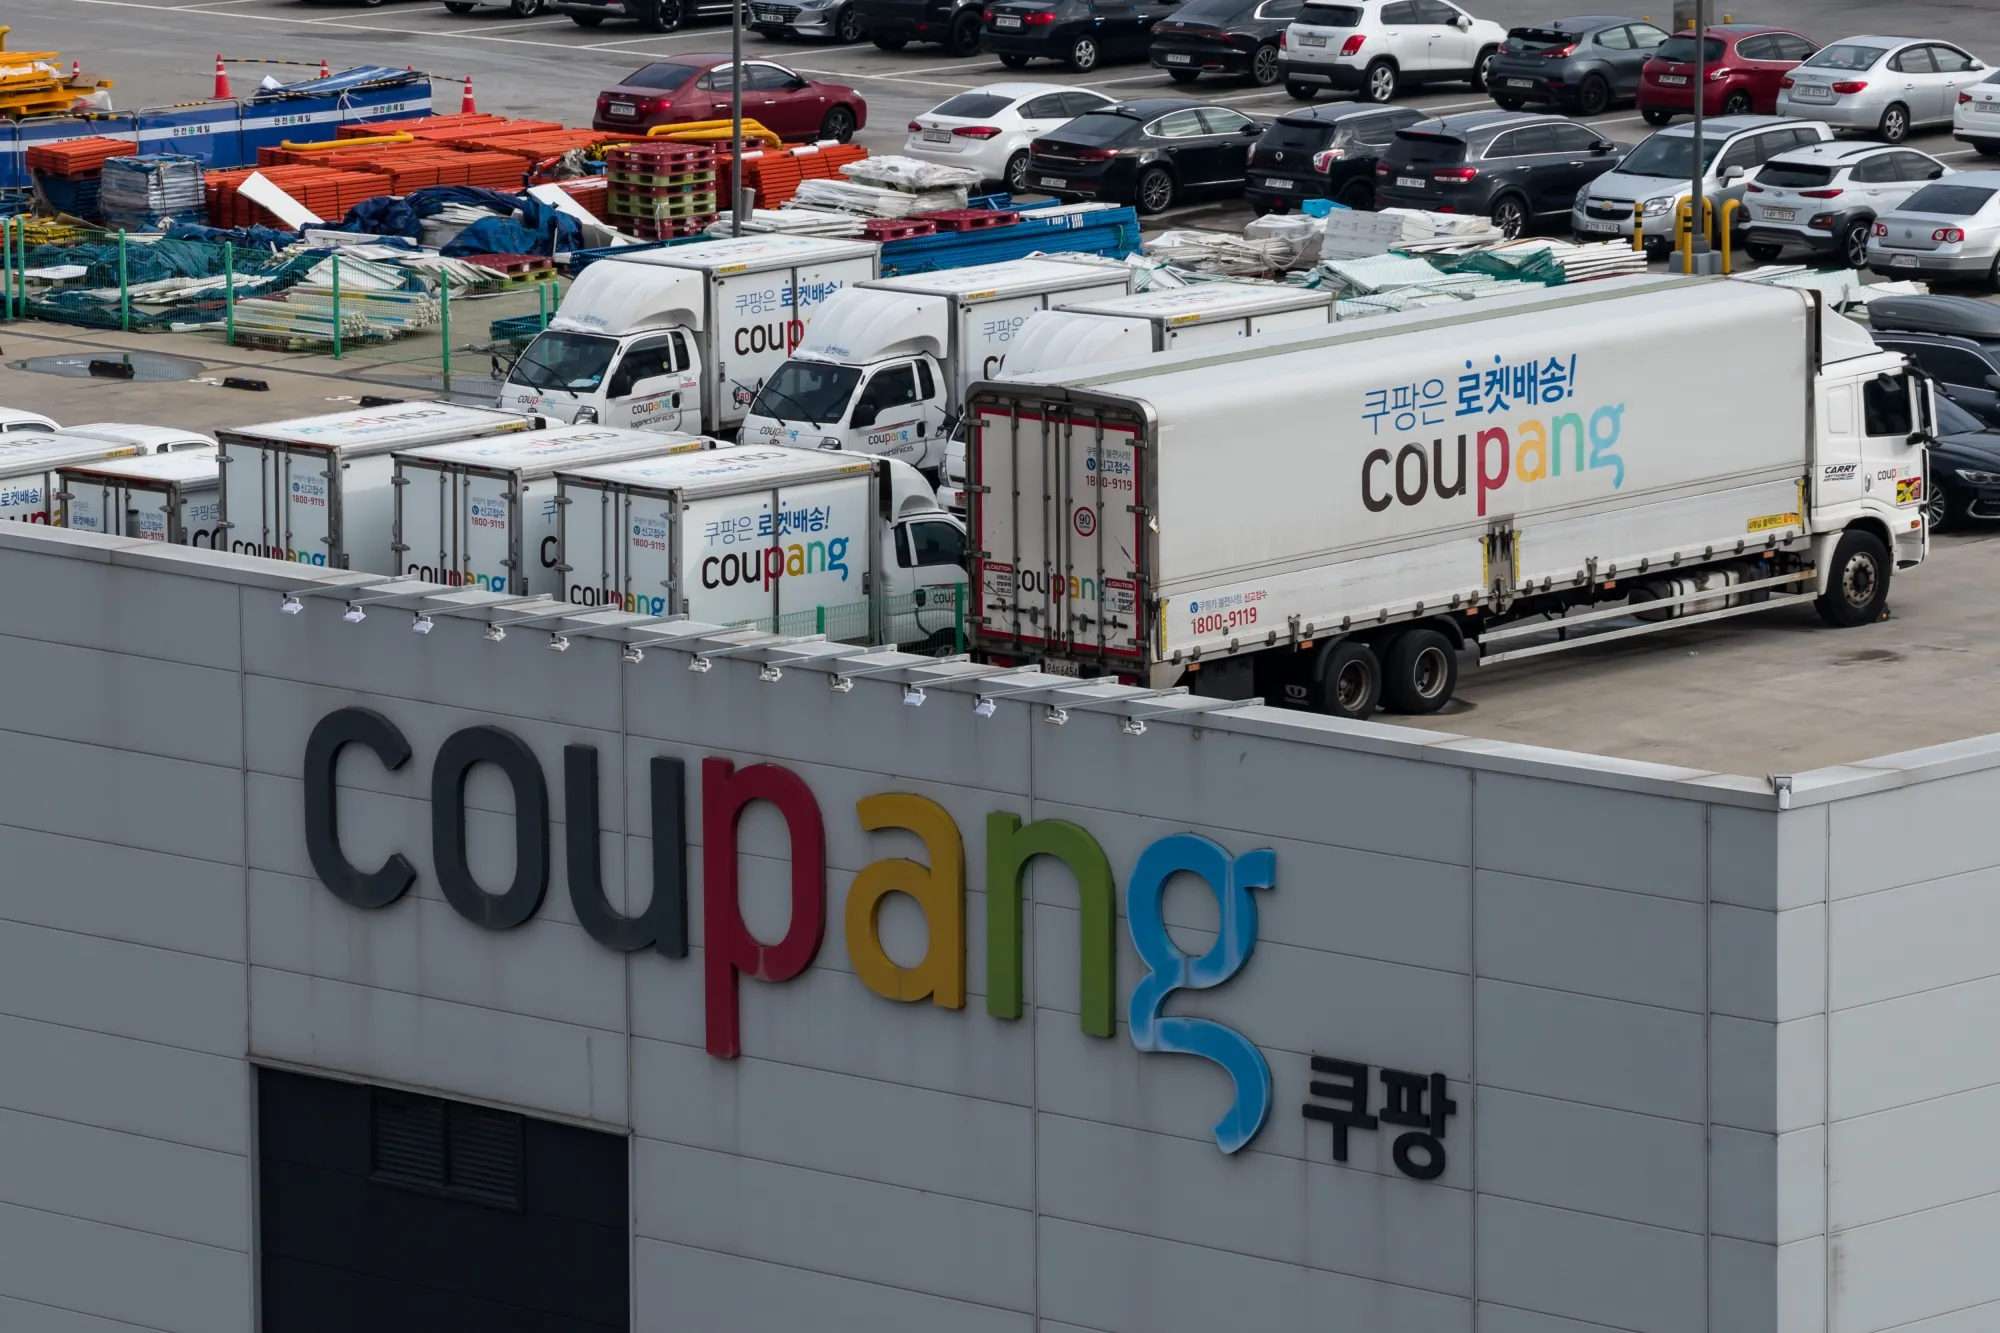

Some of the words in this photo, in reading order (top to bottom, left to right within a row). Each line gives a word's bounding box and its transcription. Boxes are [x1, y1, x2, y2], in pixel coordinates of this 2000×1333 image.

[273, 117, 288, 125] 안전
[297, 114, 311, 123] 제일
[172, 127, 187, 136] 안전
[196, 125, 210, 134] 제일
[735, 289, 776, 315] 쿠팡은
[735, 318, 812, 358] coup
[1362, 379, 1447, 435] 쿠팡은
[1455, 354, 1576, 416] 로켓배송!
[631, 398, 670, 415] coupang
[759, 426, 799, 442] coupang
[868, 430, 908, 446] coupang
[1362, 402, 1625, 516] coupang
[1825, 465, 1857, 474] CARRY
[0, 485, 42, 507] 로켓배송!
[301, 483, 325, 496] 신고접수
[292, 494, 325, 507] 1800-9119
[190, 503, 220, 522] 쿠팡은
[480, 506, 506, 518] 신고접수
[1079, 513, 1091, 526] 90
[140, 518, 164, 531] 신고접수
[471, 516, 505, 529] 1800-9119
[704, 516, 754, 546] 쿠팡은
[757, 501, 830, 537] 로켓배송!
[139, 530, 164, 541] 00-9119
[641, 526, 666, 539] 신고접수
[632, 537, 665, 551] 1800-9119
[702, 537, 849, 592] coupang
[990, 563, 1012, 573] CAUTION
[1016, 568, 1104, 604] oupan
[1111, 580, 1134, 590] CAUTION
[570, 584, 665, 618] coupang
[1199, 599, 1218, 612] 쿠팡카
[1218, 594, 1242, 608] 불편사항
[1244, 590, 1268, 603] 신고접수
[1190, 607, 1258, 635] 1800-9119
[304, 706, 1277, 1155] coupang
[1302, 1055, 1457, 1180] 쿠팡
